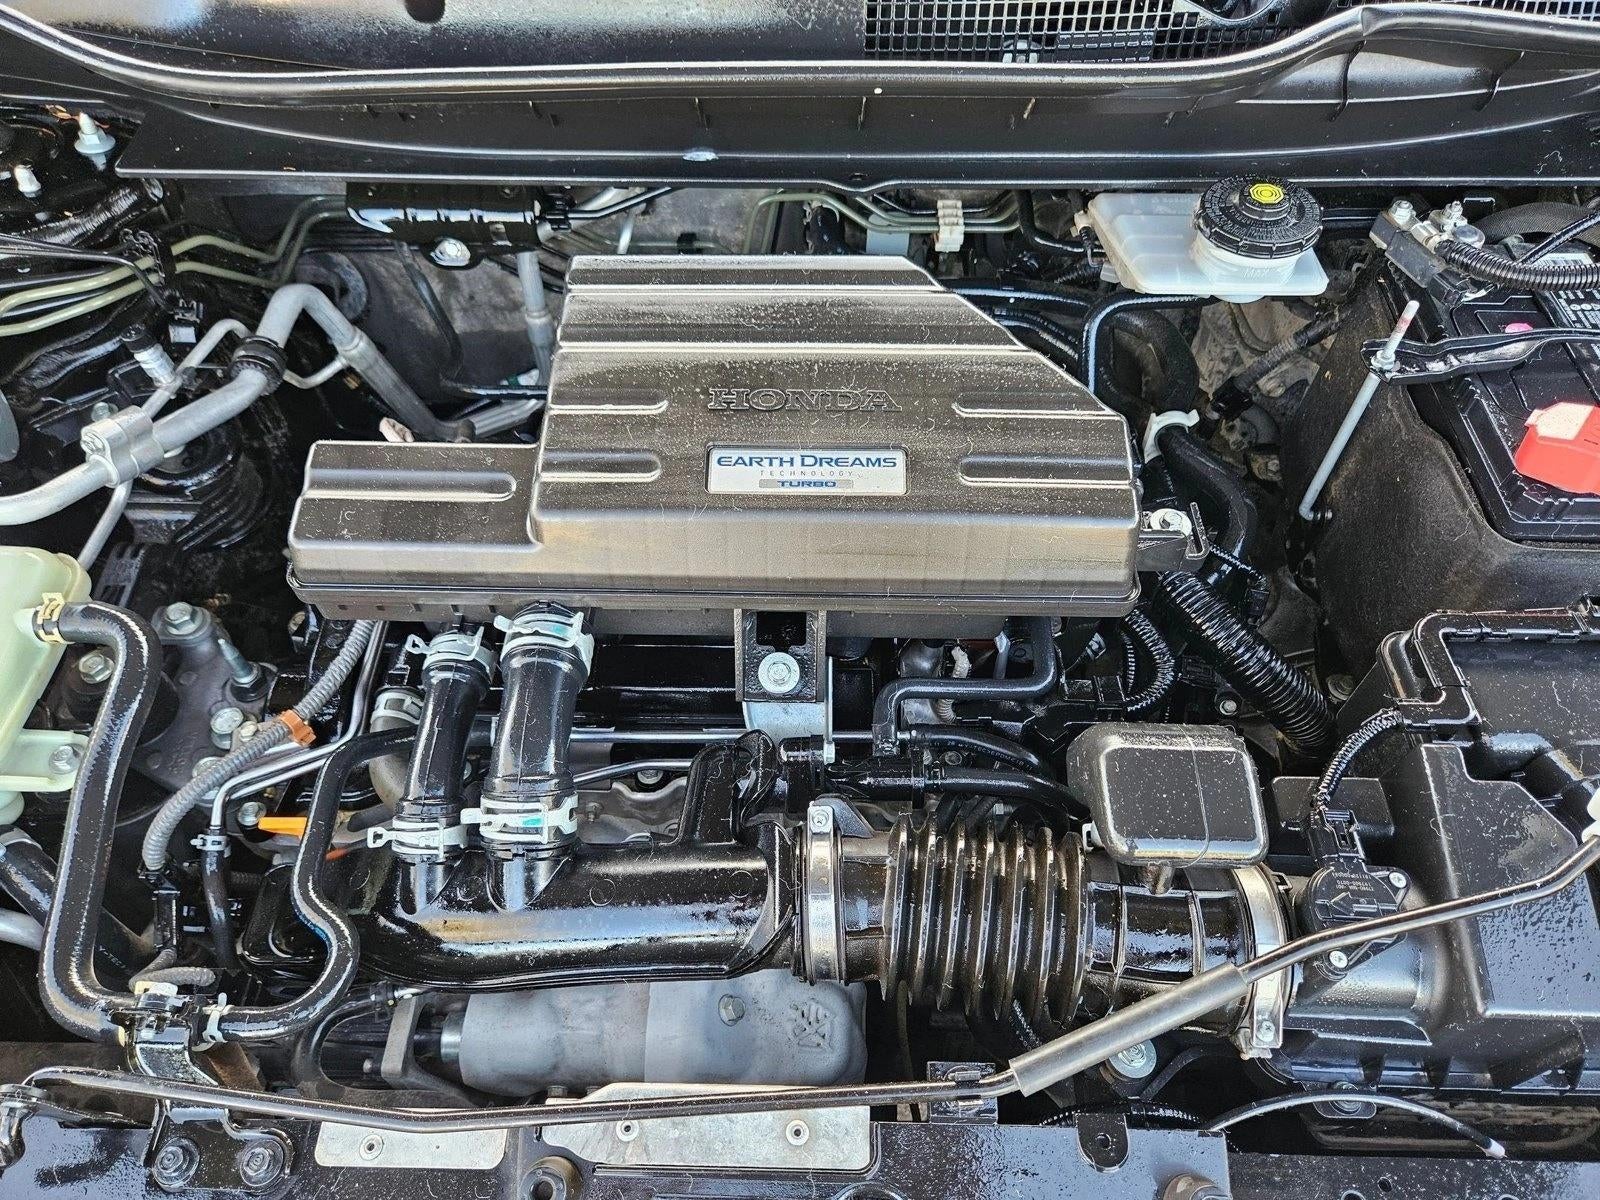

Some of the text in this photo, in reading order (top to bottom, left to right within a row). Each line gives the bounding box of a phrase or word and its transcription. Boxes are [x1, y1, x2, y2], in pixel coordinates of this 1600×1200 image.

[707, 388, 903, 411] HONDA
[716, 454, 897, 468] EARTH DREAMS
[777, 479, 837, 488] TURBO
